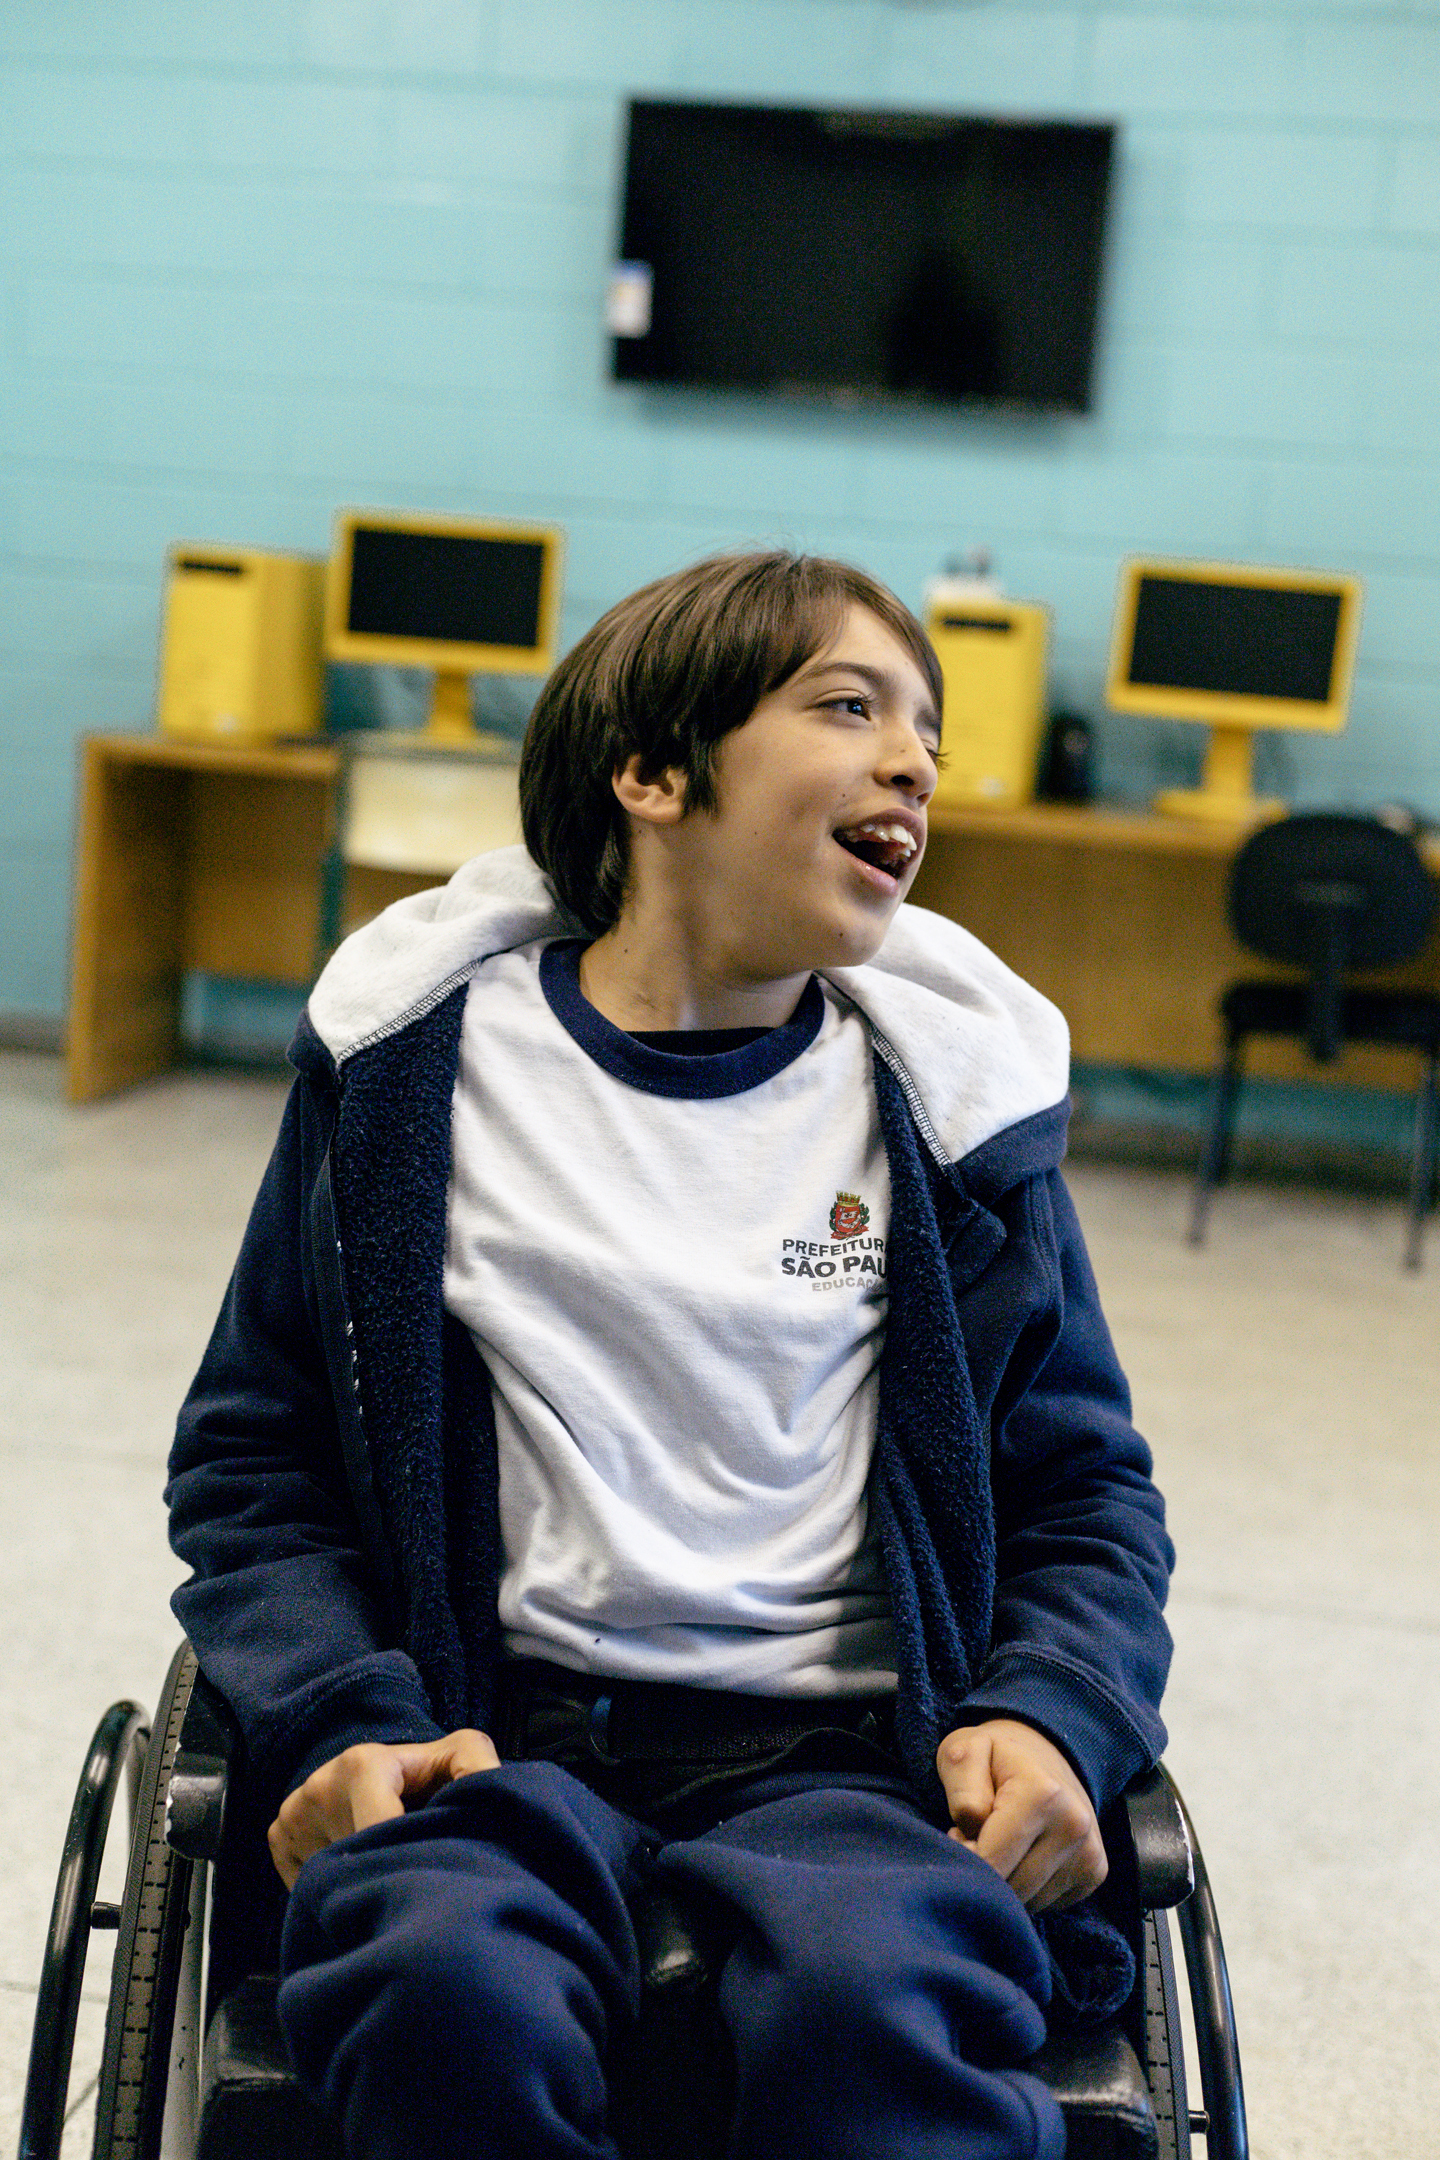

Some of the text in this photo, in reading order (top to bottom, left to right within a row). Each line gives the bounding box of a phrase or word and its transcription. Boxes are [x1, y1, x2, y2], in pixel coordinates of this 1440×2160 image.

[782, 1238, 885, 1257] PREFEITUR
[781, 1255, 886, 1279] SÃO PAU
